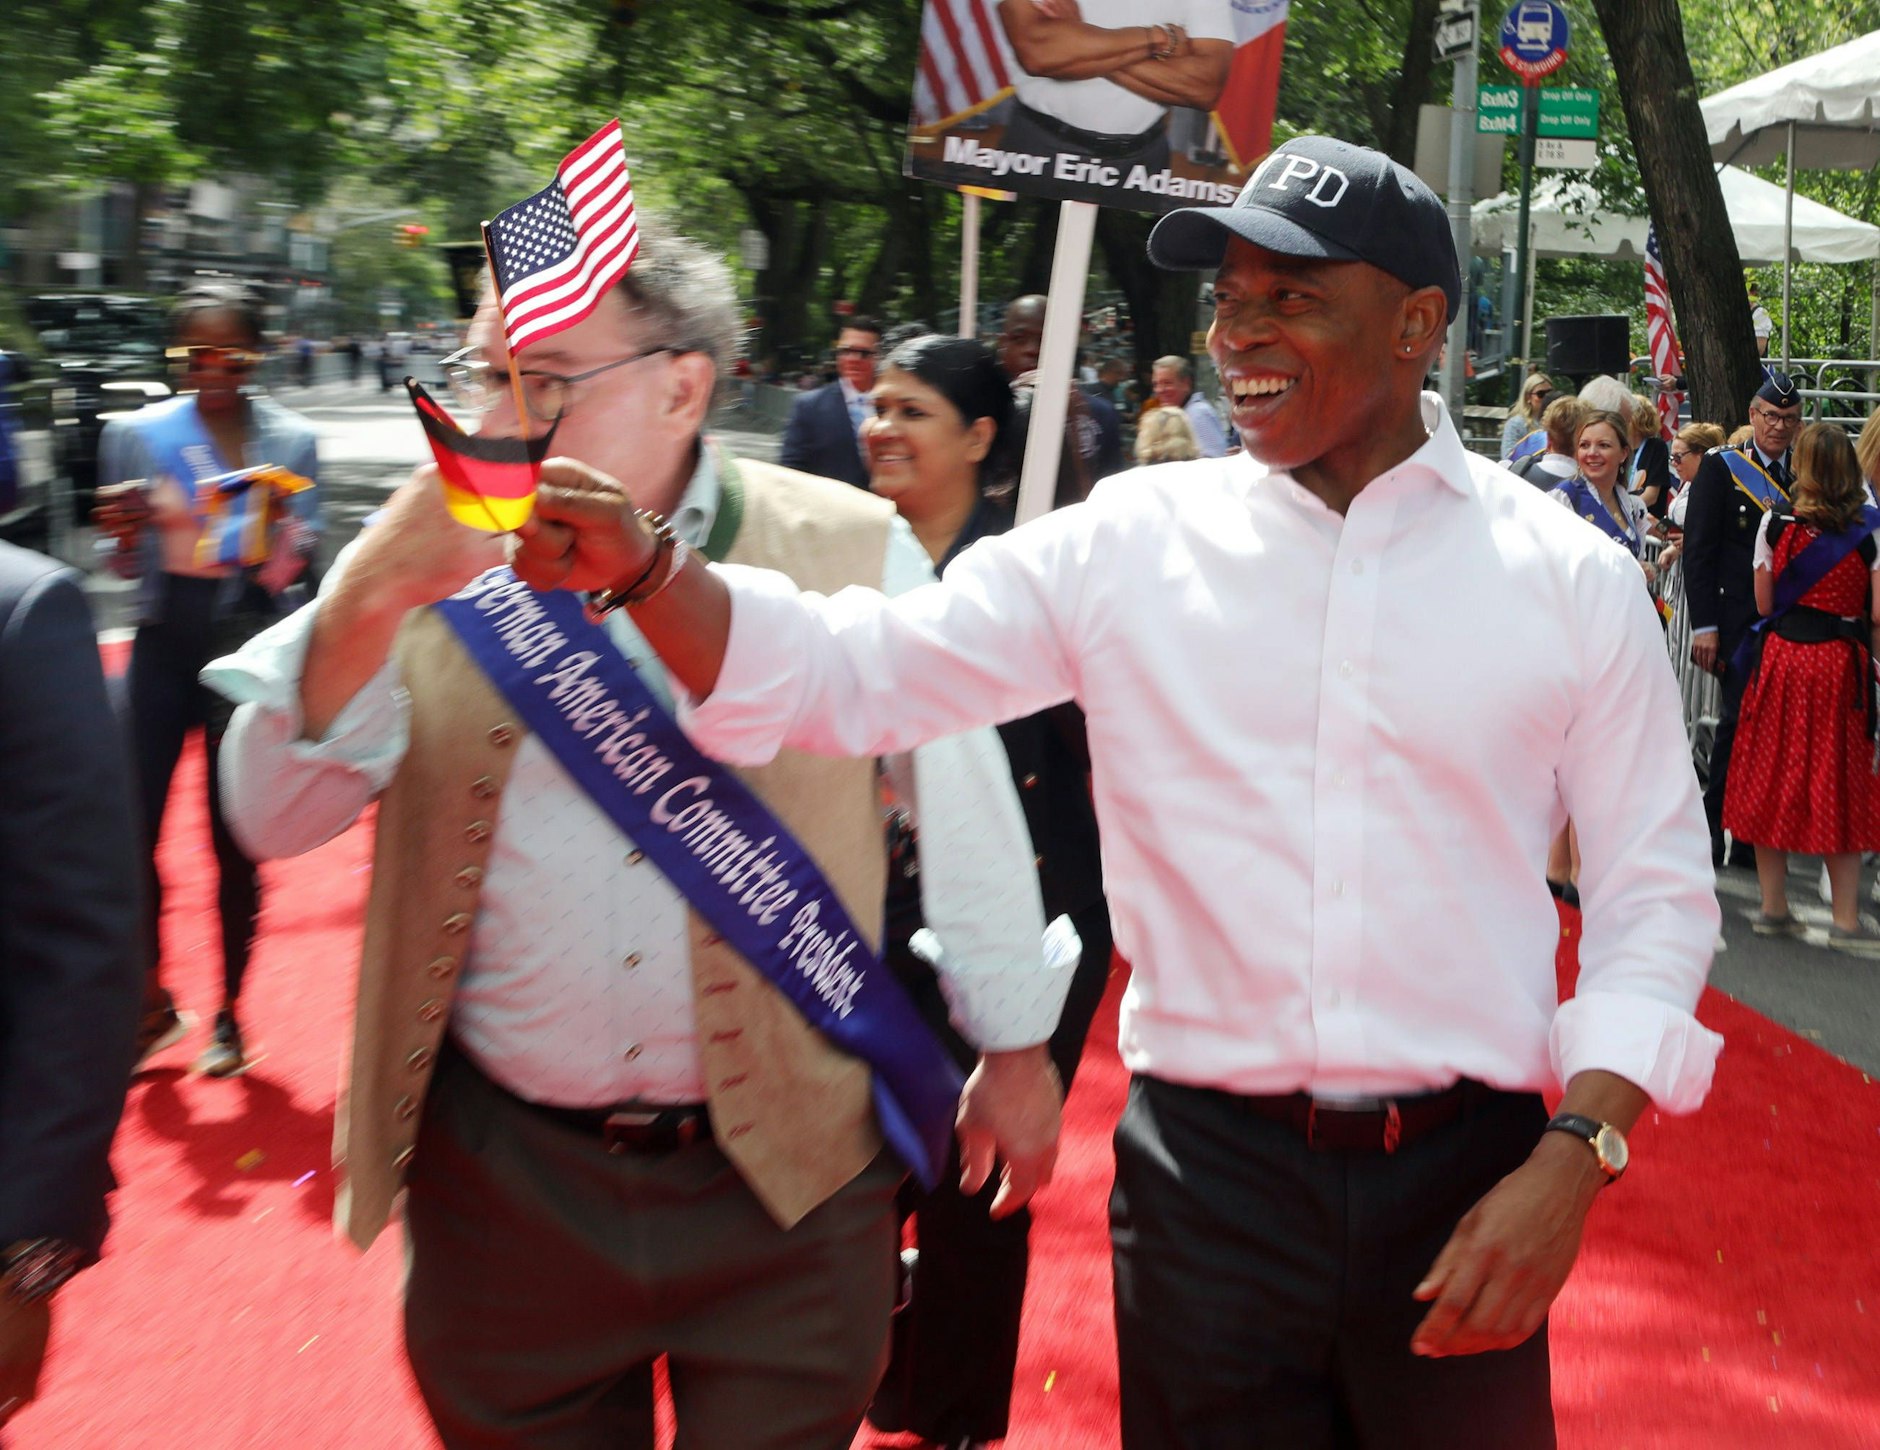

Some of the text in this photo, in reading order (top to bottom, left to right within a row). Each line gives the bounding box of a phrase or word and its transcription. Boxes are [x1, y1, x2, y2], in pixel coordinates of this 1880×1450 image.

[1503, 49, 1563, 73] NO STANDING
[1480, 89, 1519, 109] BxM3
[1478, 113, 1517, 132] BxM4
[944, 136, 1239, 205] Mayor Eric Adams
[535, 650, 674, 796] American
[650, 776, 799, 926] Committee
[777, 898, 865, 1020] President
